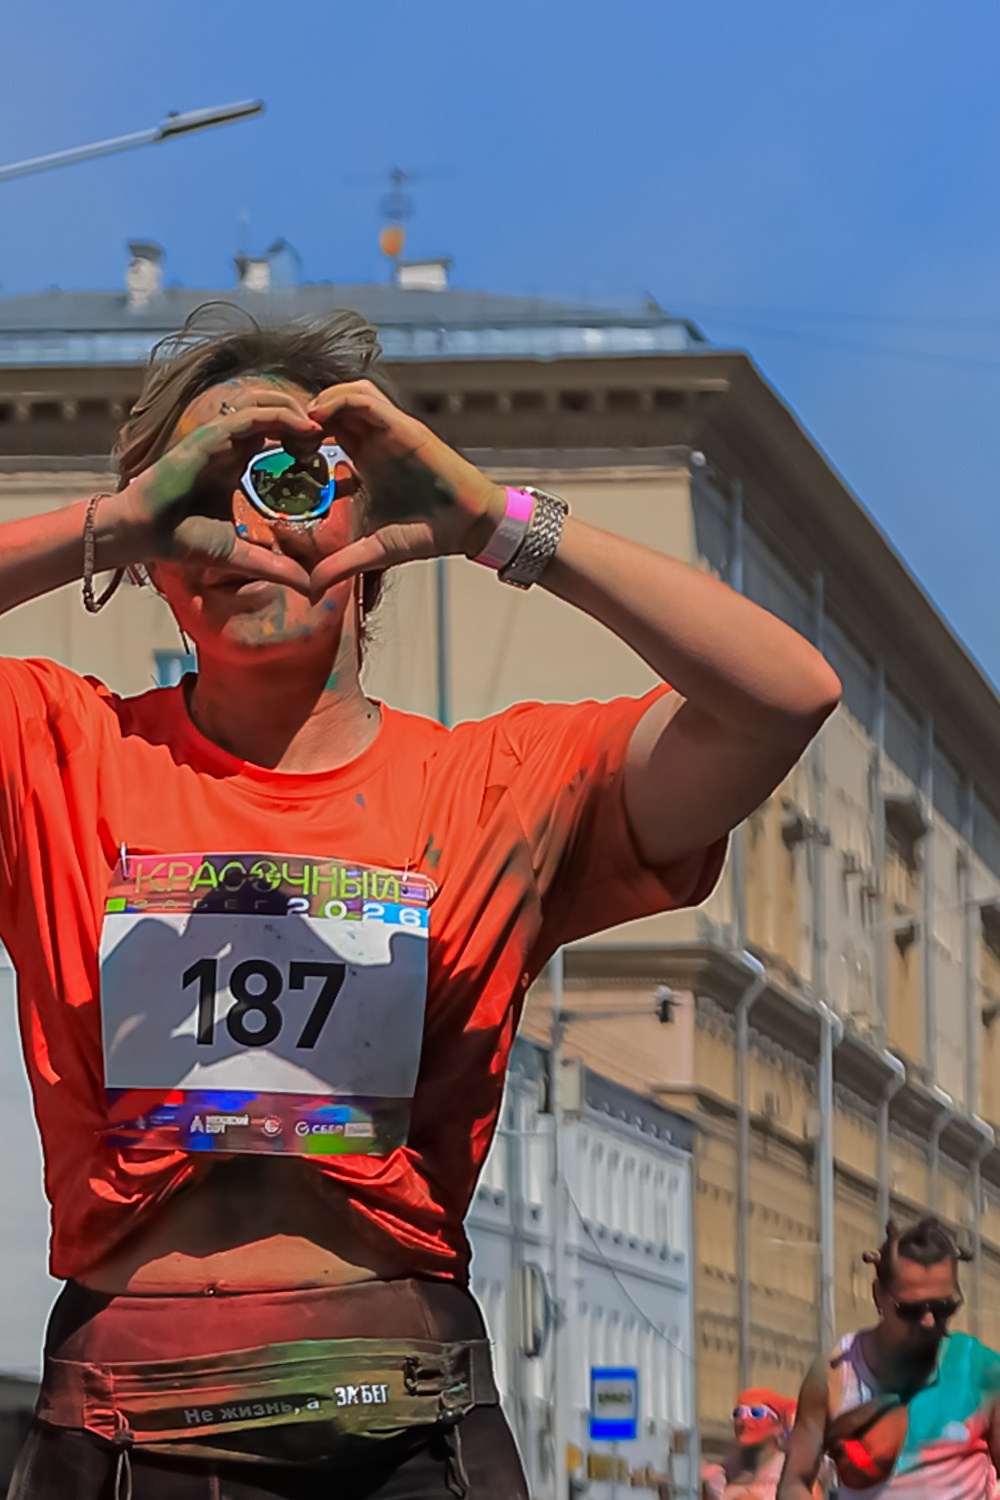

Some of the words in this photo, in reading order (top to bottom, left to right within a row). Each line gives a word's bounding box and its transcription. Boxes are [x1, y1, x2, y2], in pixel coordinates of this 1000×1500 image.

[134, 859, 400, 903] КРАСОЧНЫЙ
[286, 896, 422, 928] 2026
[181, 957, 347, 1050] 187
[184, 1408, 215, 1424] Не
[221, 1400, 301, 1420] жизнь,
[306, 1397, 321, 1410] а
